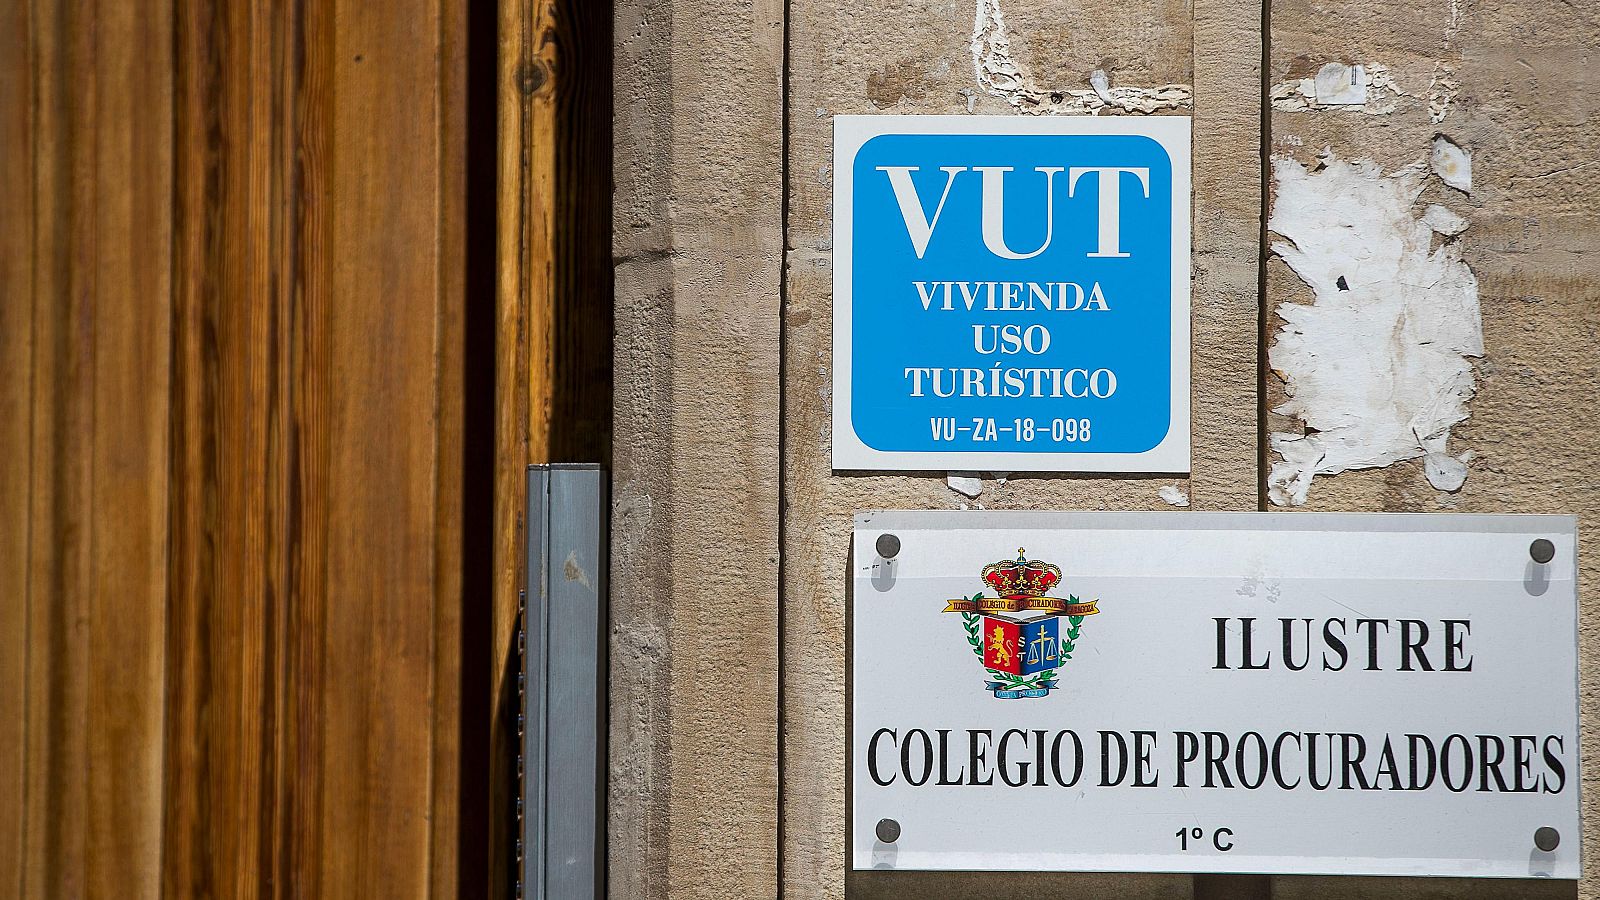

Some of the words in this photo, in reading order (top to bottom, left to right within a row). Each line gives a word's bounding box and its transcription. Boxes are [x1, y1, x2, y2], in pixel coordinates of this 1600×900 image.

[875, 166, 1151, 260] VUT
[912, 281, 1111, 311] VIVIENDA
[971, 324, 1051, 355] USO
[904, 361, 1117, 399] TURÍSTICO
[930, 417, 1091, 442] VU-ZA-18-098
[1018, 636, 1026, 648] S
[1212, 617, 1474, 672] ILUSTRE
[867, 727, 1084, 788] COLEGIO
[1097, 730, 1158, 788] DE
[1173, 731, 1566, 795] PROCURADORES
[1176, 827, 1203, 851] 1º
[1214, 827, 1234, 852] C
